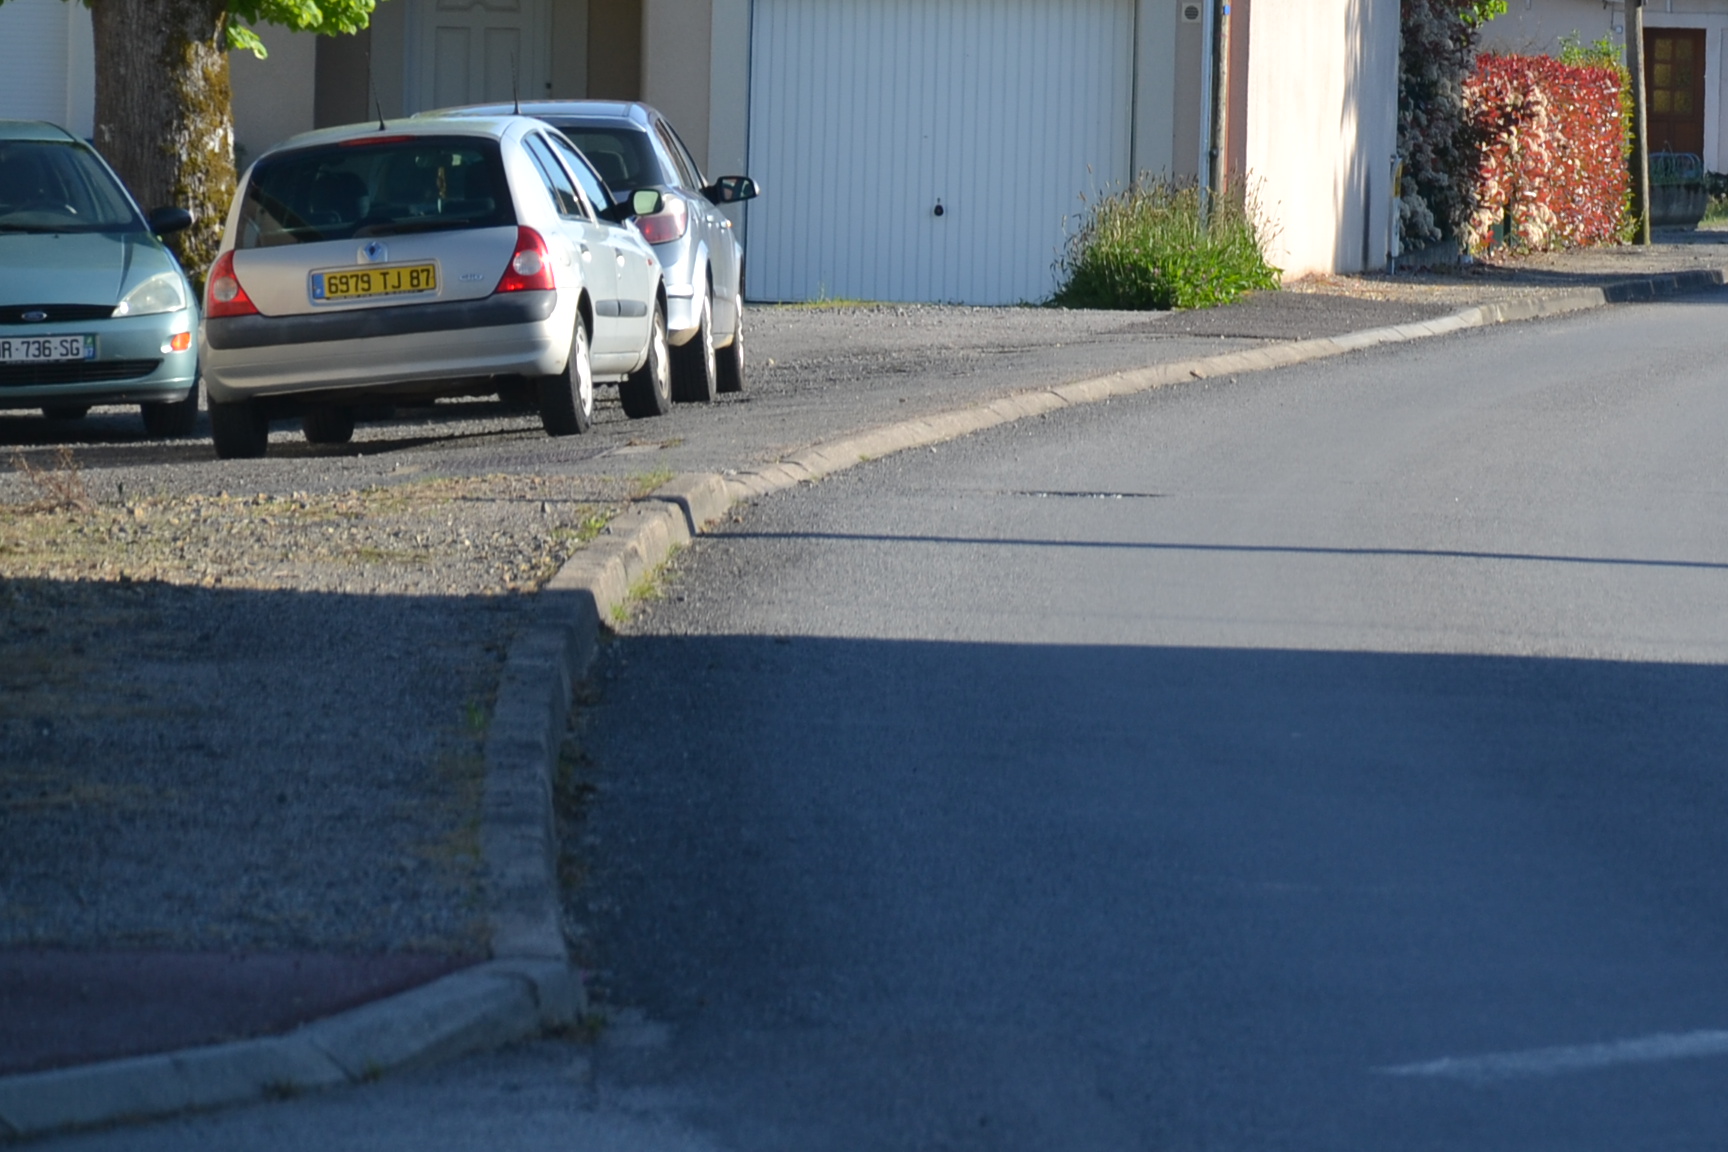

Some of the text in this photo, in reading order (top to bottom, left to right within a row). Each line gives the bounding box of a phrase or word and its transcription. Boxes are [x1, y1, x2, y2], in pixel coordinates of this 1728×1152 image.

[327, 274, 372, 295] 6979
[380, 271, 401, 290] TJ
[409, 268, 431, 288] 87
[0, 339, 80, 359] R-736-SG
